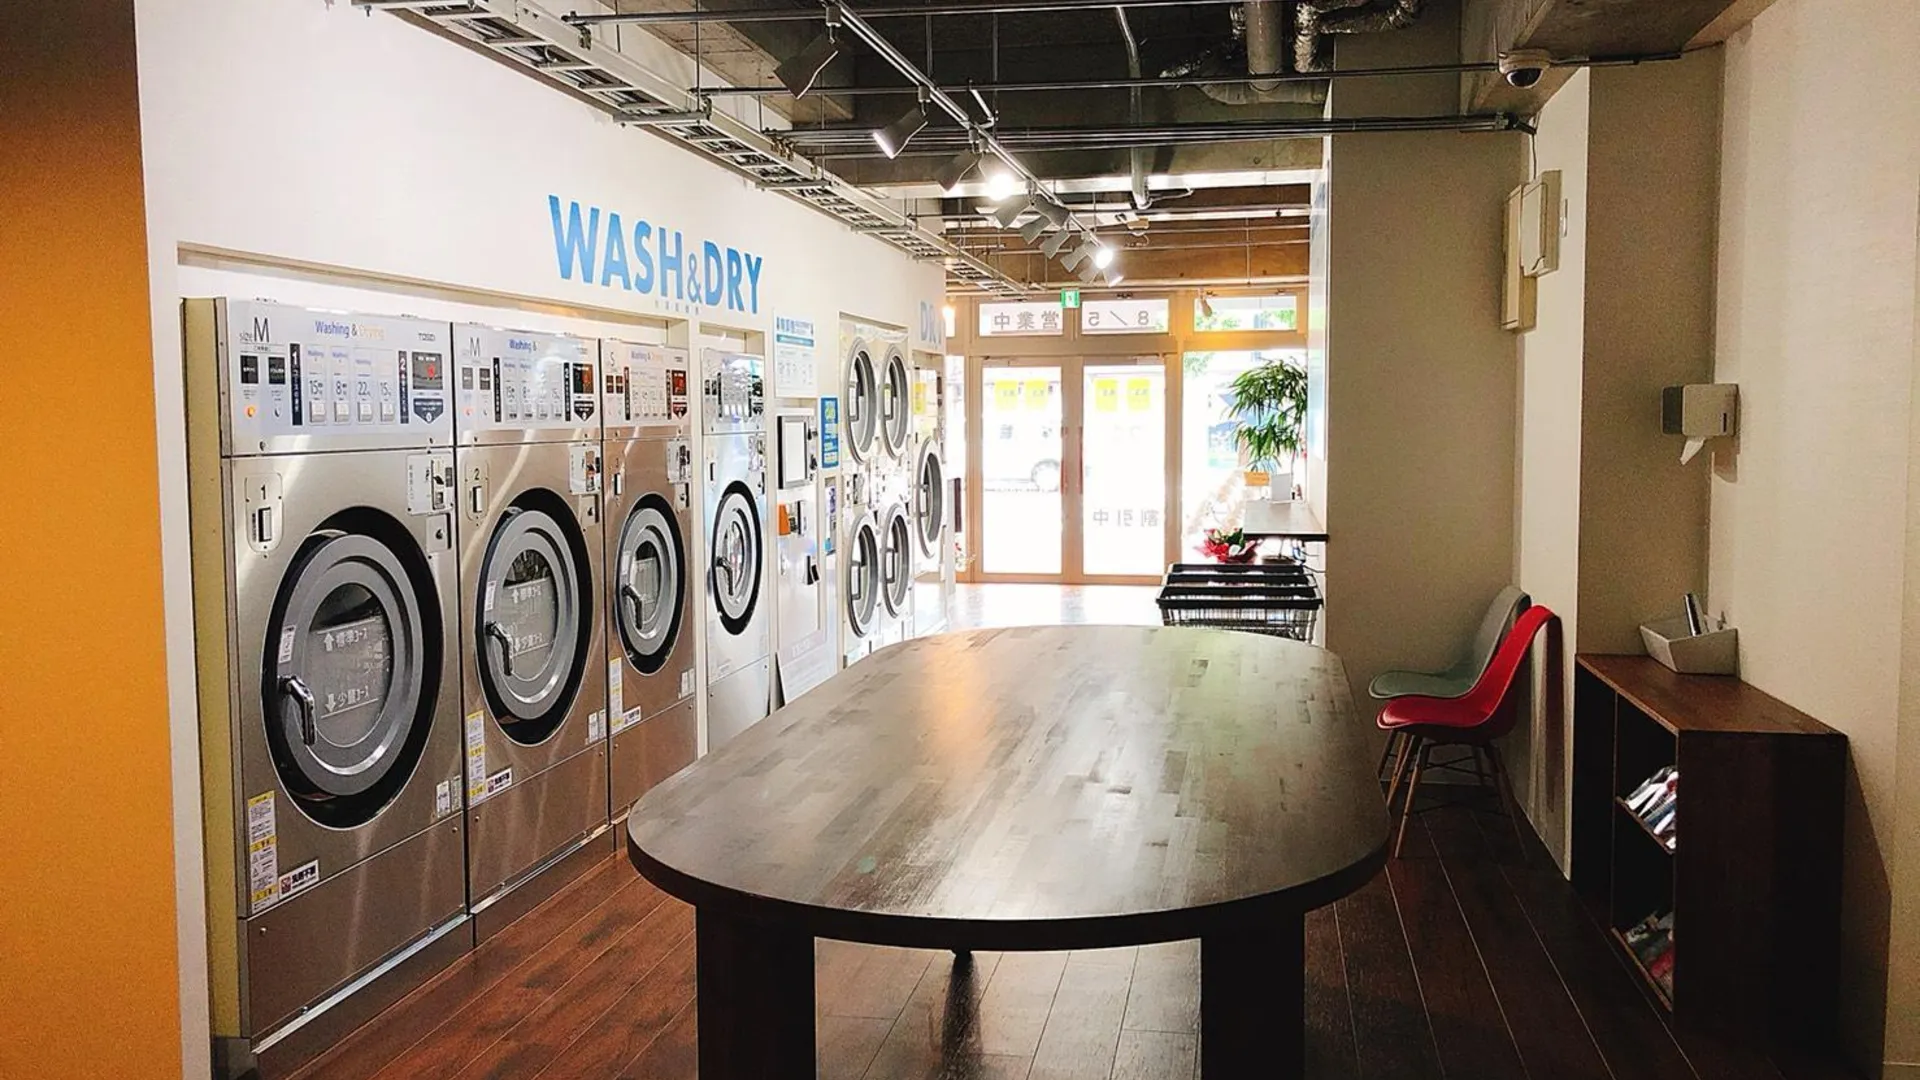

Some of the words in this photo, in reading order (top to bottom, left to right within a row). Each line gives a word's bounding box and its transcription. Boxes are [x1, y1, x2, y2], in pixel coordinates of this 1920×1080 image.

[548, 195, 762, 315] WASH&DRY
[254, 316, 270, 343] M
[314, 320, 350, 339] Washing
[351, 323, 358, 336] &
[470, 337, 480, 356] M
[473, 468, 480, 480] 2
[260, 484, 266, 500] 1
